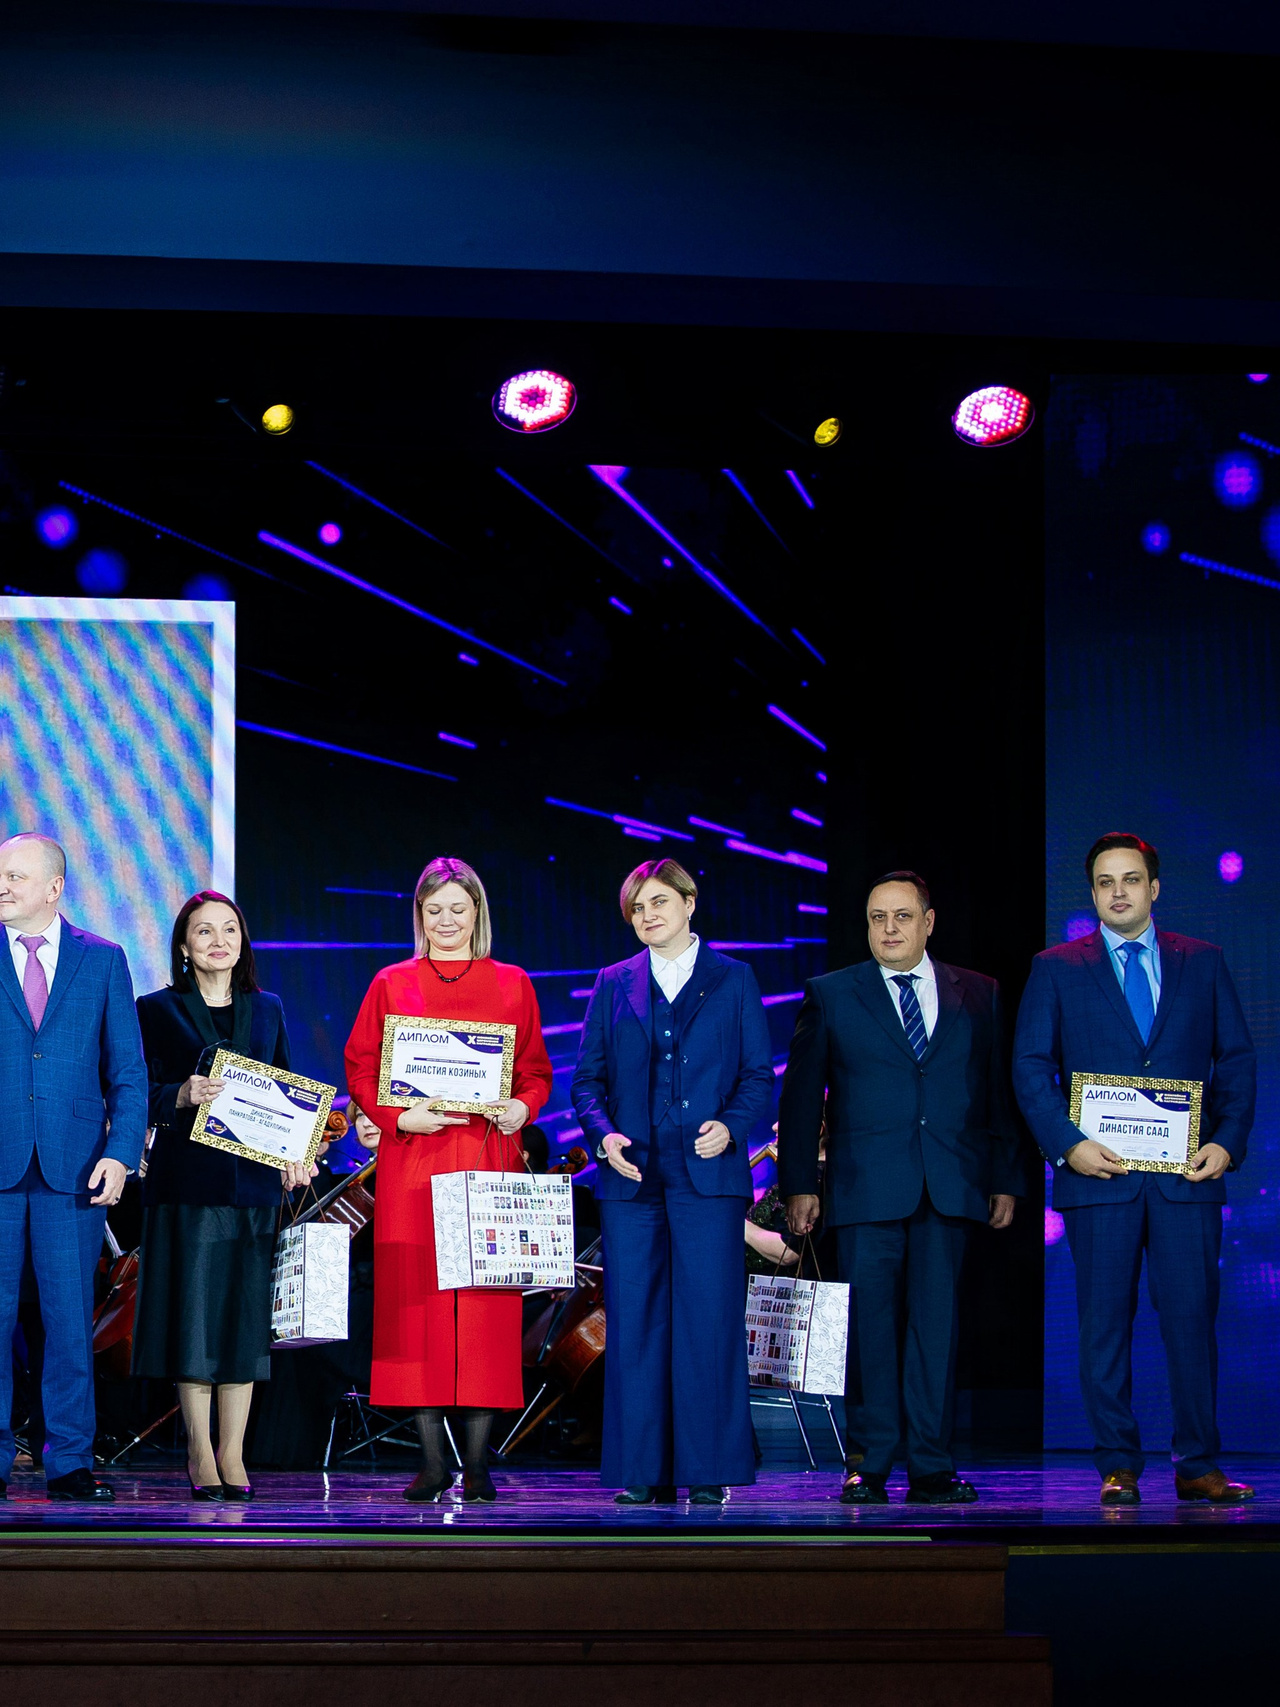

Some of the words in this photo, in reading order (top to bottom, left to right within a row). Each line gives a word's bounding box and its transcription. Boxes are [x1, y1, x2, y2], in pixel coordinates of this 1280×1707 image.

[397, 1032, 449, 1044] ДИПЛОМ
[405, 1064, 447, 1076] ДИНАСТИЯ
[448, 1067, 487, 1079] КОЗИНЫХ
[223, 1068, 272, 1091] ДИПЛОМ
[1085, 1090, 1137, 1102] ДИПЛОМ
[250, 1109, 274, 1120] ДИНАСТИЯ
[1098, 1122, 1144, 1136] ДИНАСТИЯ
[1146, 1125, 1170, 1138] СААД
